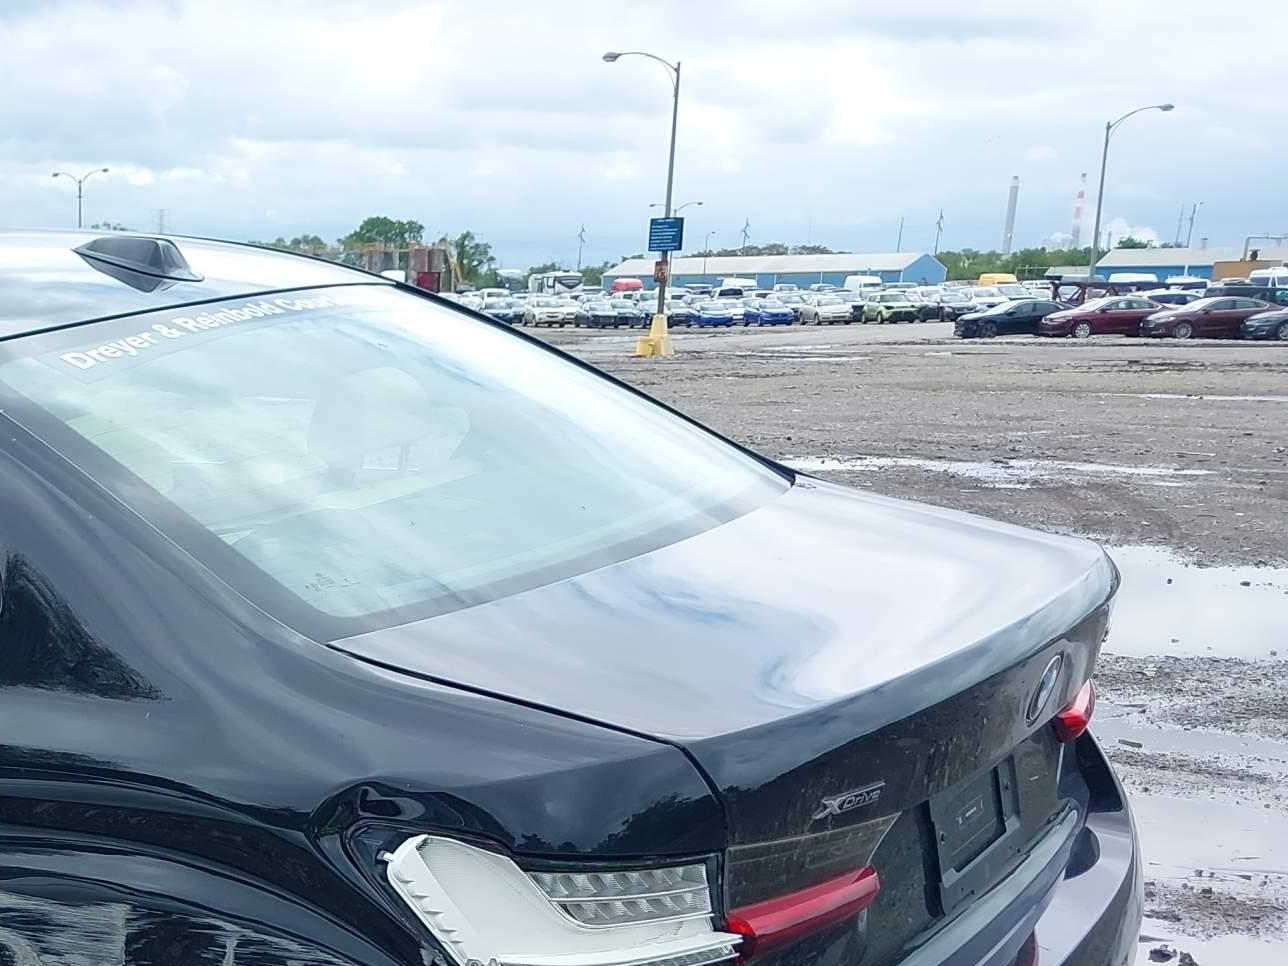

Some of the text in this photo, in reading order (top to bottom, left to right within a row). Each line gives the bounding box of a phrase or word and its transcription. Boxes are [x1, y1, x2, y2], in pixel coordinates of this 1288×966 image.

[59, 331, 159, 370] Dreyer
[152, 323, 186, 339] &
[172, 301, 285, 332] Reinbold
